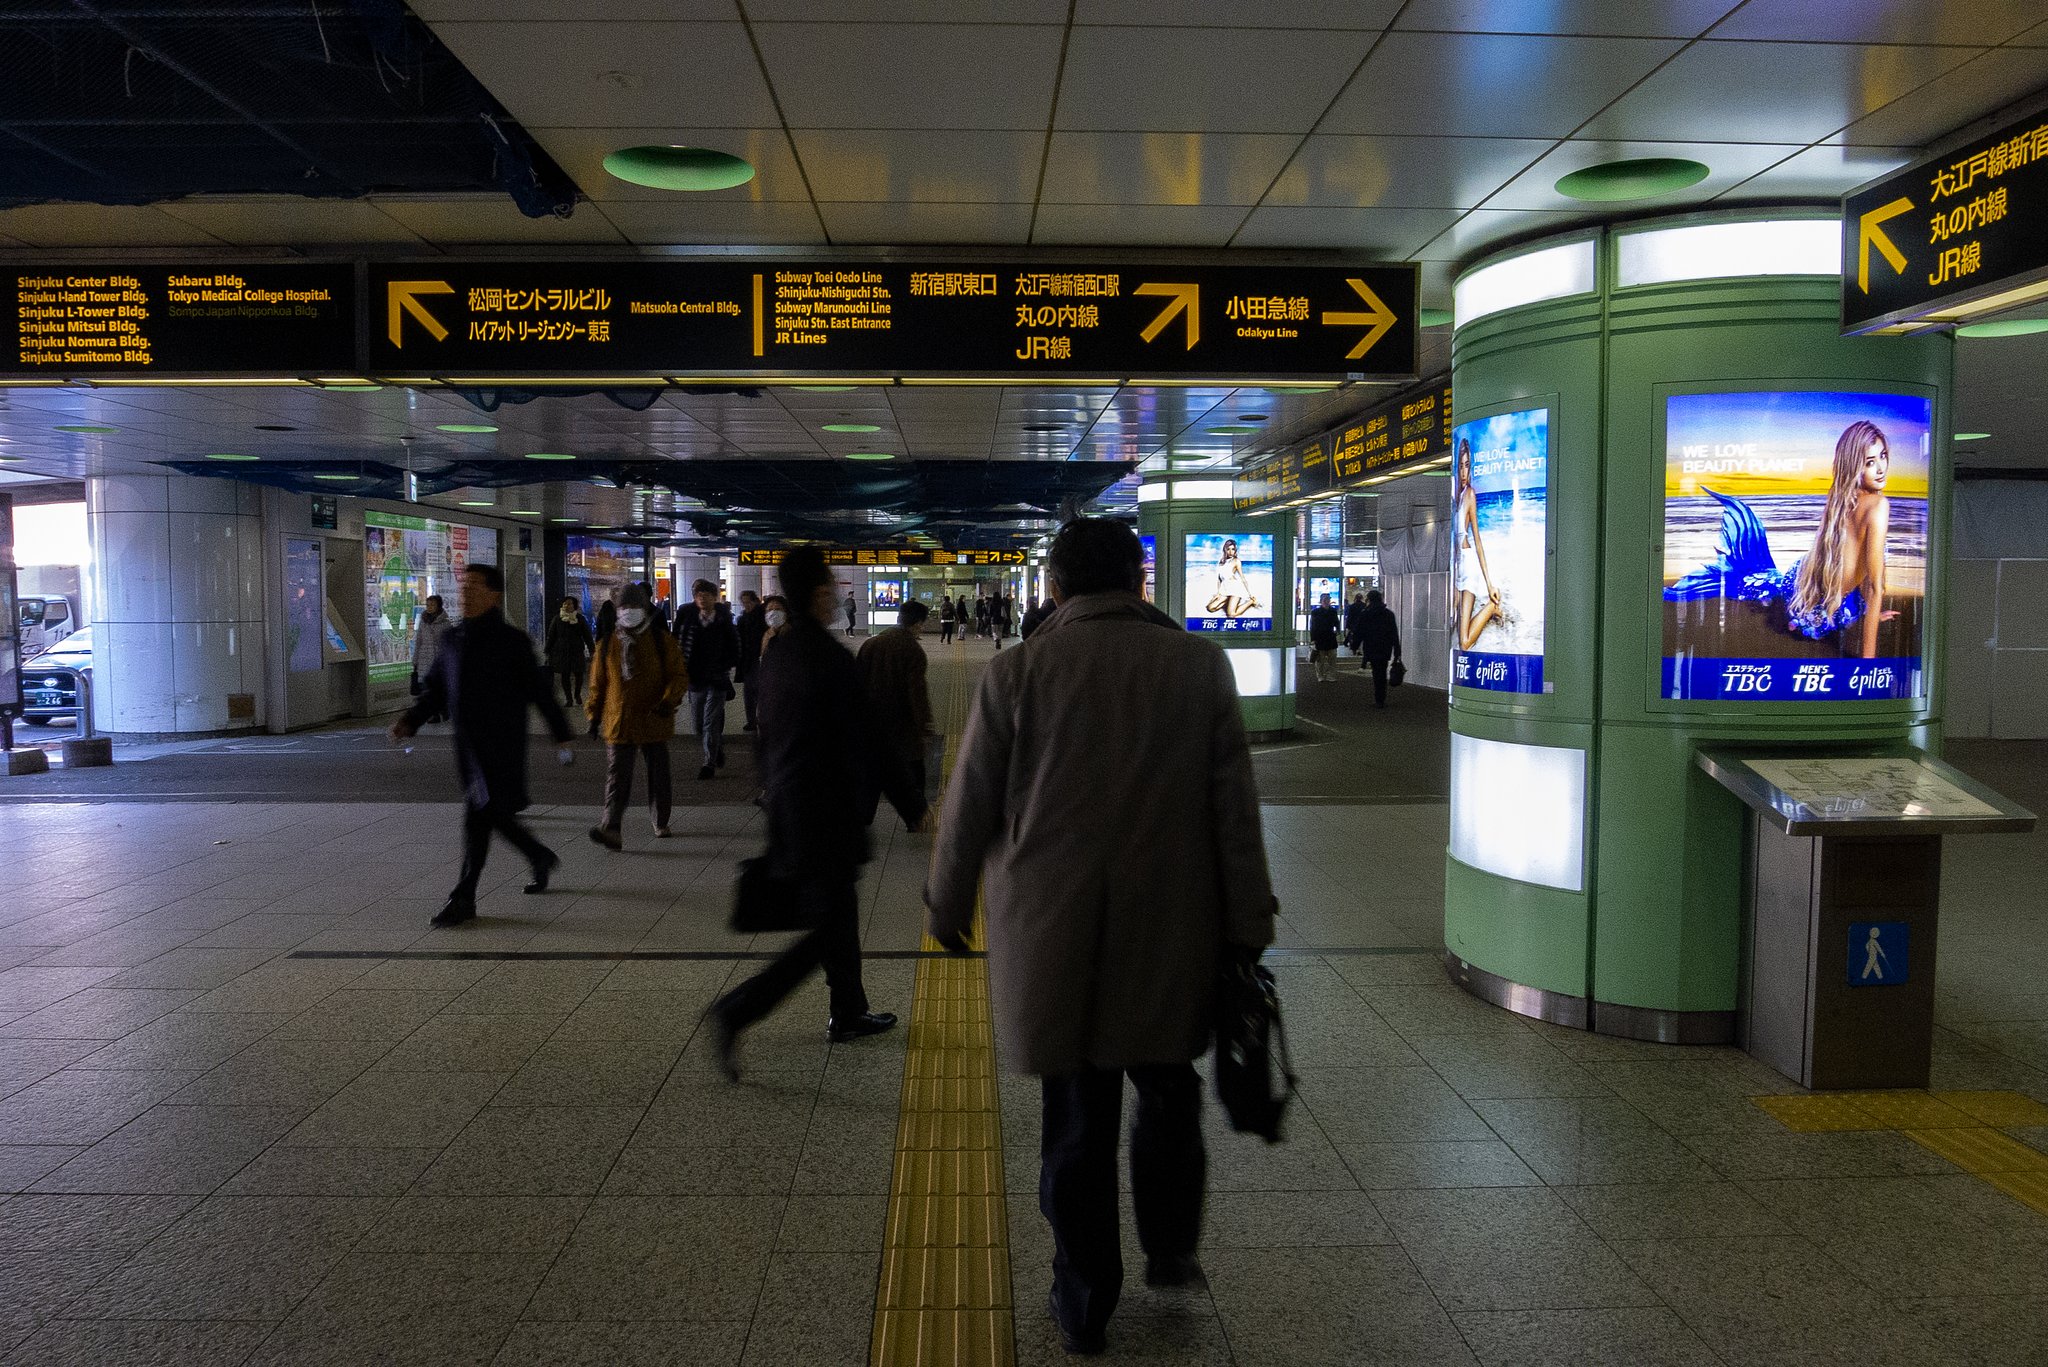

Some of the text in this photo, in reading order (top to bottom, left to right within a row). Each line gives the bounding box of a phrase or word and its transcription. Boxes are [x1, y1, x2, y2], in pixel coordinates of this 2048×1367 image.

[1929, 186, 2008, 244] 丸の内線
[1928, 240, 1982, 286] JR線
[17, 275, 141, 290] Sinjuku Center Bldg.
[167, 274, 247, 289] Subaru Bldg.
[775, 271, 883, 286] Subway Toei Oedo Line
[909, 271, 997, 296] 新宿駅東口
[1015, 272, 1120, 297] 大江戸線新宿西口駅
[17, 289, 149, 305] Sinjuku I-land Tower Bldg.
[167, 289, 331, 304] Tokyo Medical College Hospital.
[468, 287, 612, 312] 松岡セントラルビル
[872, 286, 892, 299] Stn.
[18, 305, 150, 320] Sinjuku L-Tower Bldg.
[630, 300, 742, 317] Matsuoka Central Bldg.
[775, 301, 891, 317] Subway Marunouchi Line
[1015, 303, 1100, 328] 丸の内線
[1225, 295, 1310, 321] 小田急線
[18, 319, 141, 335] Sinjuku Mitsui Bldg.
[469, 319, 611, 343] ハイアット リージェンシー 東京
[775, 316, 891, 332] Sinjuku Stn. East Entrance
[775, 331, 827, 344] JR Lines
[1236, 327, 1298, 340] Odakyu Line
[19, 334, 152, 350] Sinjuku Nomura Bldg.
[1015, 335, 1072, 360] JR線
[19, 349, 154, 365] Sinjuku Sumitomo Bldg.
[1473, 446, 1510, 463] WE LOVE
[1682, 443, 1756, 458] WE LOVE
[1473, 457, 1544, 476] BEAUTY PLANET
[1682, 458, 1807, 474] BEAUTY PLANET
[1223, 621, 1238, 629] TBC
[1456, 663, 1471, 680] TBC
[1475, 659, 1508, 686] épiler
[1725, 664, 1772, 674] エステティック
[1798, 664, 1830, 674] MEN'S
[1721, 666, 1893, 696] TBC TBC épiler
